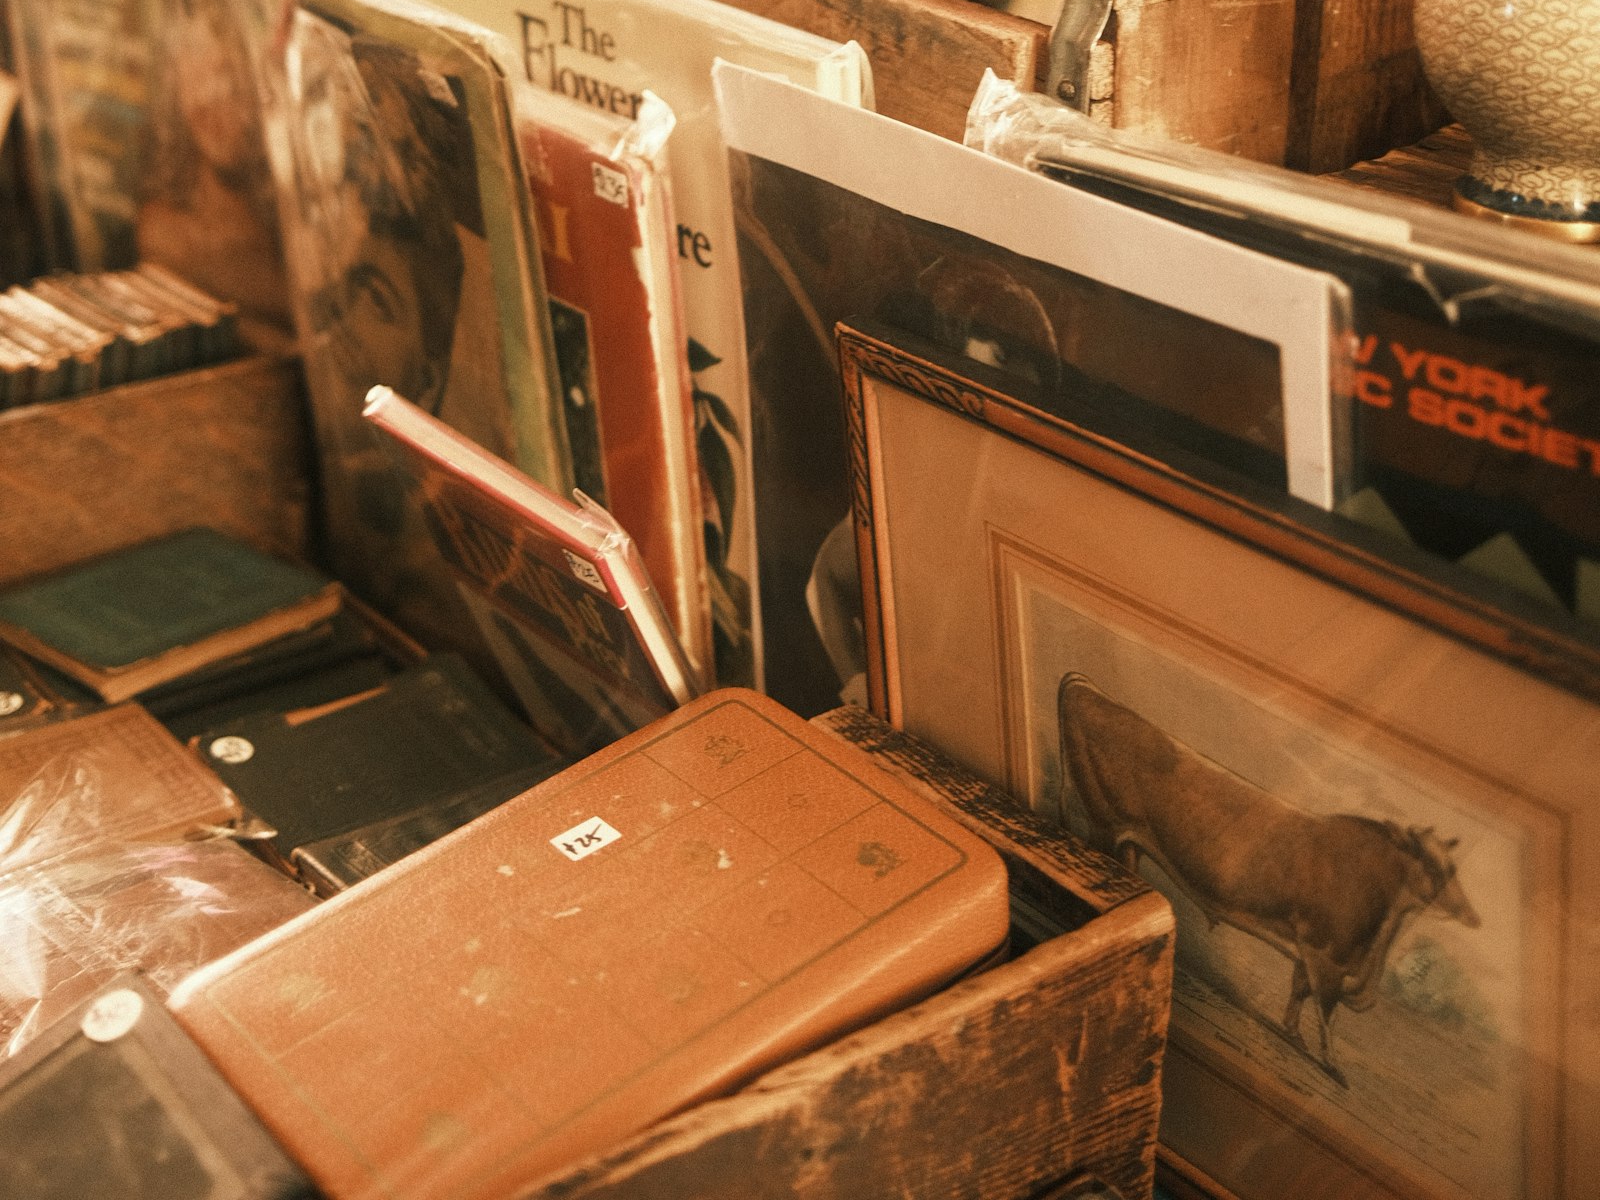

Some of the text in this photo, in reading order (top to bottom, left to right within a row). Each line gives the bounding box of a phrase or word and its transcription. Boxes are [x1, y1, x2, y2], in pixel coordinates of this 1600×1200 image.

[552, 0, 617, 63] The
[676, 223, 713, 269] re
[1390, 341, 1551, 420] YORK
